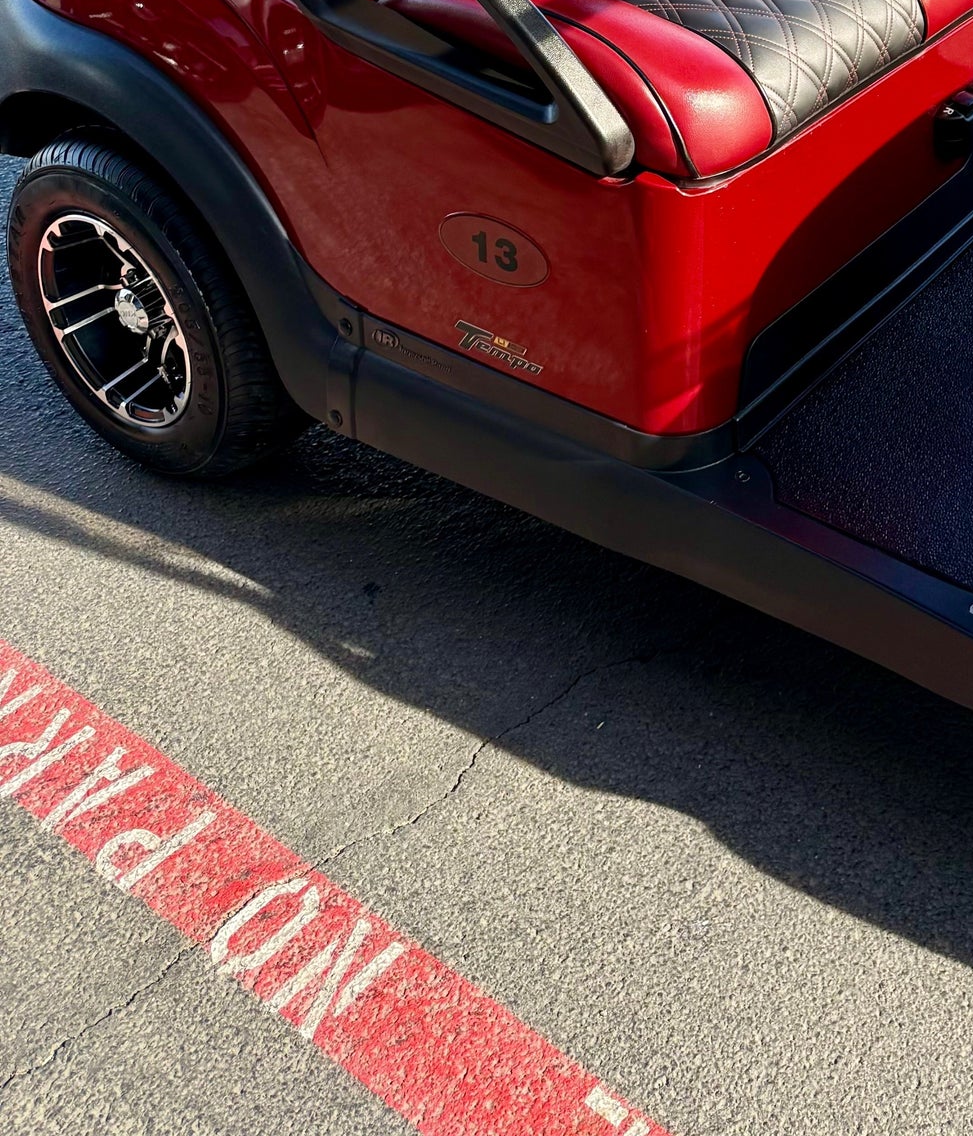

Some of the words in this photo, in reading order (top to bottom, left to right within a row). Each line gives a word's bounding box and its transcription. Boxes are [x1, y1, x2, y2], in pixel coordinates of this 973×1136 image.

[471, 230, 518, 273] 13
[454, 319, 543, 376] Tempo
[210, 876, 406, 1041] NO
